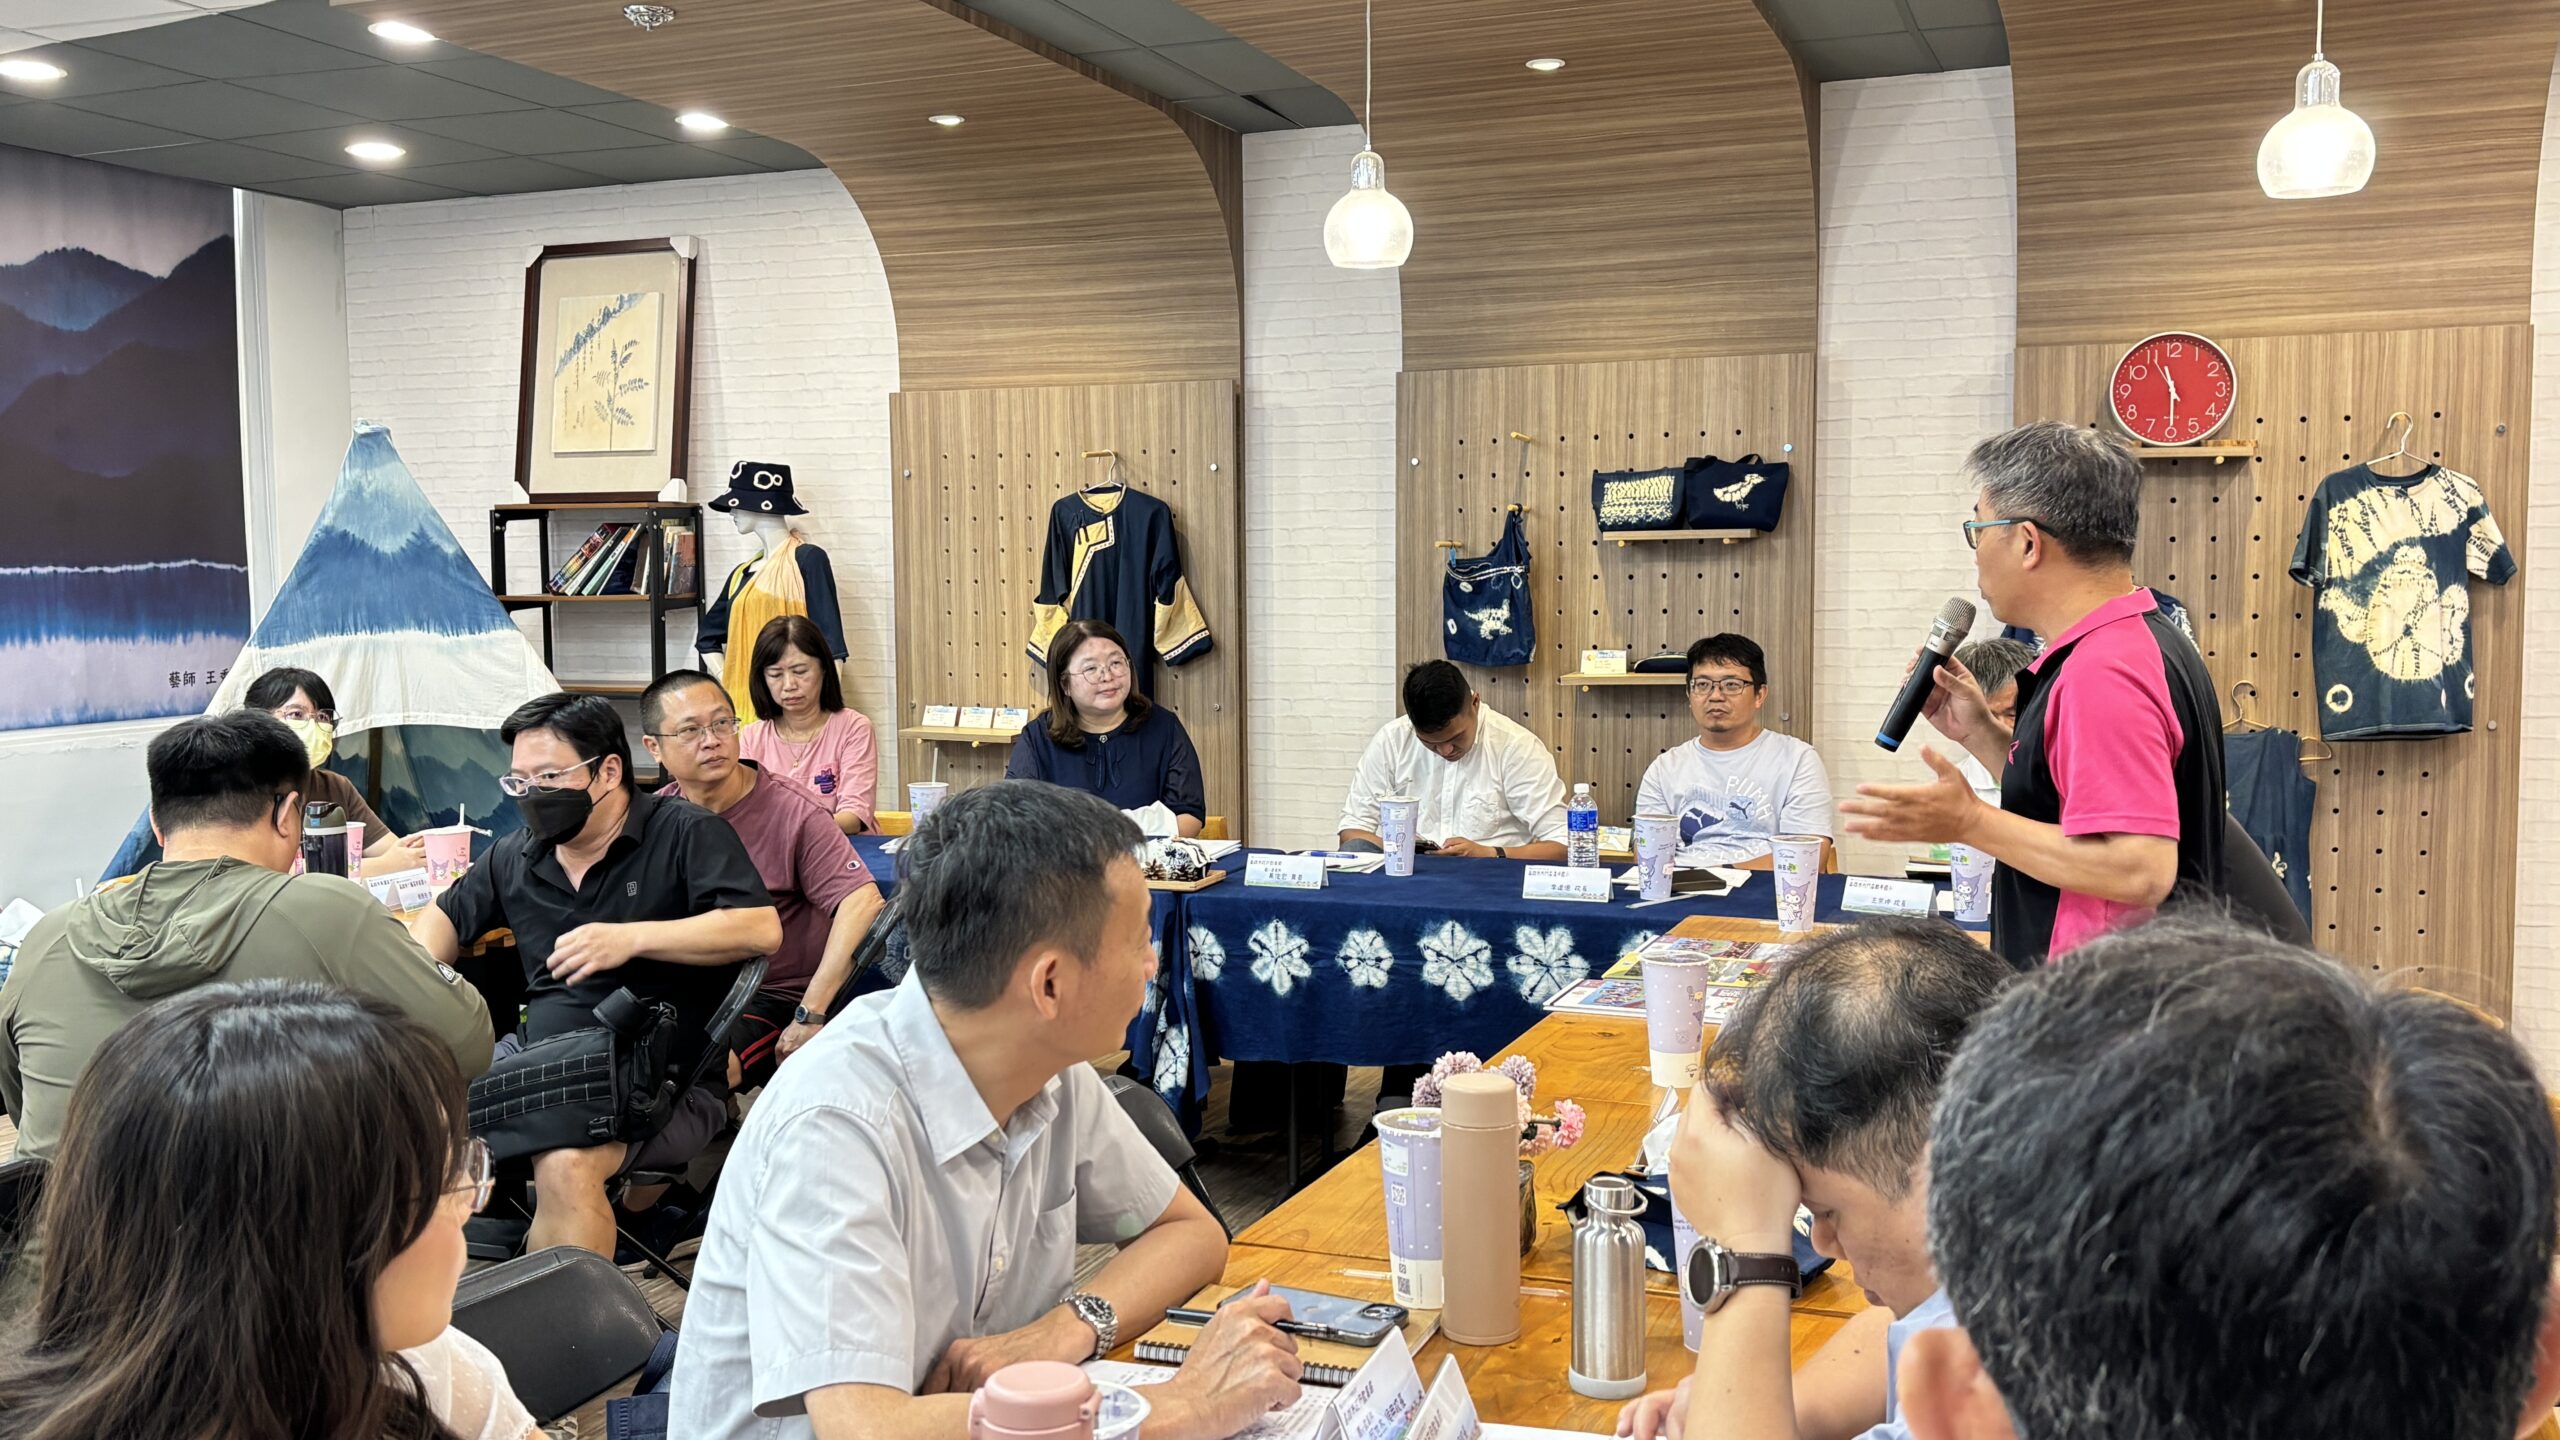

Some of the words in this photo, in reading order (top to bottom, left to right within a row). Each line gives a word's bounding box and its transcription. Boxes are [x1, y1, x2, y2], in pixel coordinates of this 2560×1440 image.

[2166, 342, 2183, 358] 12
[2129, 365, 2148, 380] 10
[2207, 361, 2220, 377] 2
[2119, 383, 2132, 399] 9
[2215, 381, 2226, 398] 3
[2126, 404, 2138, 420] 8
[2204, 402, 2216, 418] 4
[2145, 418, 2156, 434] 7
[2187, 418, 2200, 434] 5
[168, 670, 197, 689] 藝師
